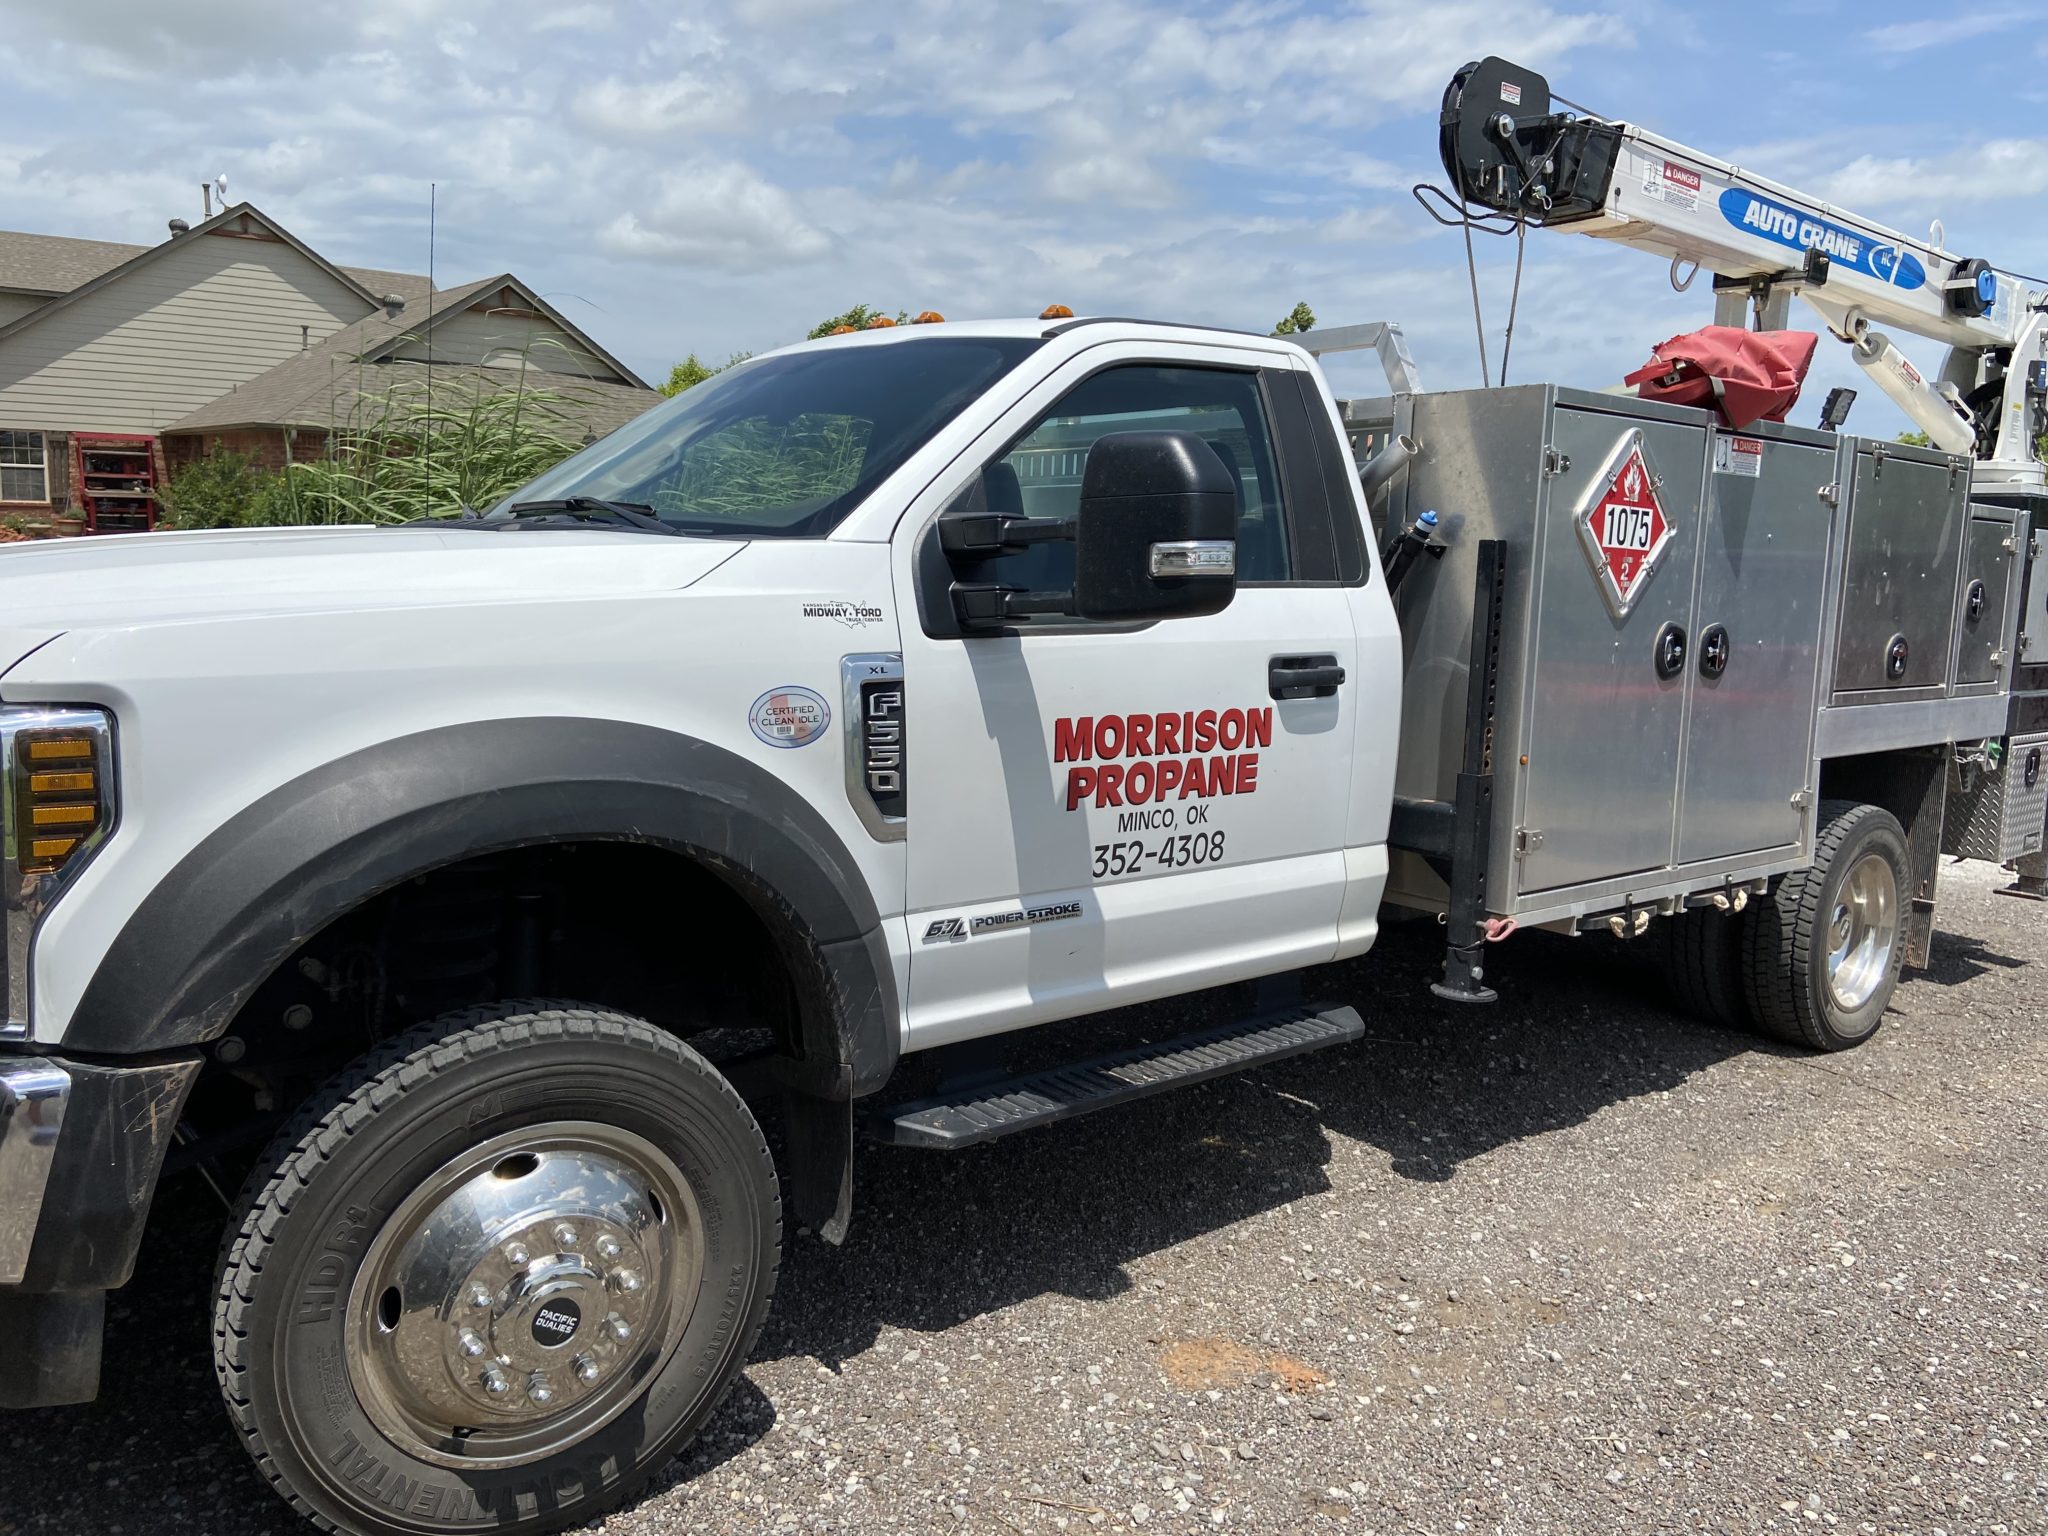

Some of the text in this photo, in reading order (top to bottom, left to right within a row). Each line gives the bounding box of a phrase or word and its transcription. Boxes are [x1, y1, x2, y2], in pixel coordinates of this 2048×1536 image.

[1673, 169, 1699, 187] DANGER
[1742, 199, 1860, 262] AUTO CRANE
[1608, 507, 1650, 548] 1075
[1620, 562, 1629, 580] 2
[804, 607, 882, 617] MIDWAY FORD
[869, 666, 888, 675] XL
[766, 705, 815, 716] CERTIFIED
[761, 715, 820, 727] CLEAN IDLE
[1053, 707, 1273, 763] MORRISON
[1066, 753, 1259, 812] PROPANE
[1117, 804, 1209, 833] MINCO, OK
[1092, 830, 1226, 879] 352-4308
[923, 902, 1081, 943] 6.7L POWER STROKE
[536, 1318, 573, 1334] DUALIES
[540, 1309, 577, 1326] PACIFIC
